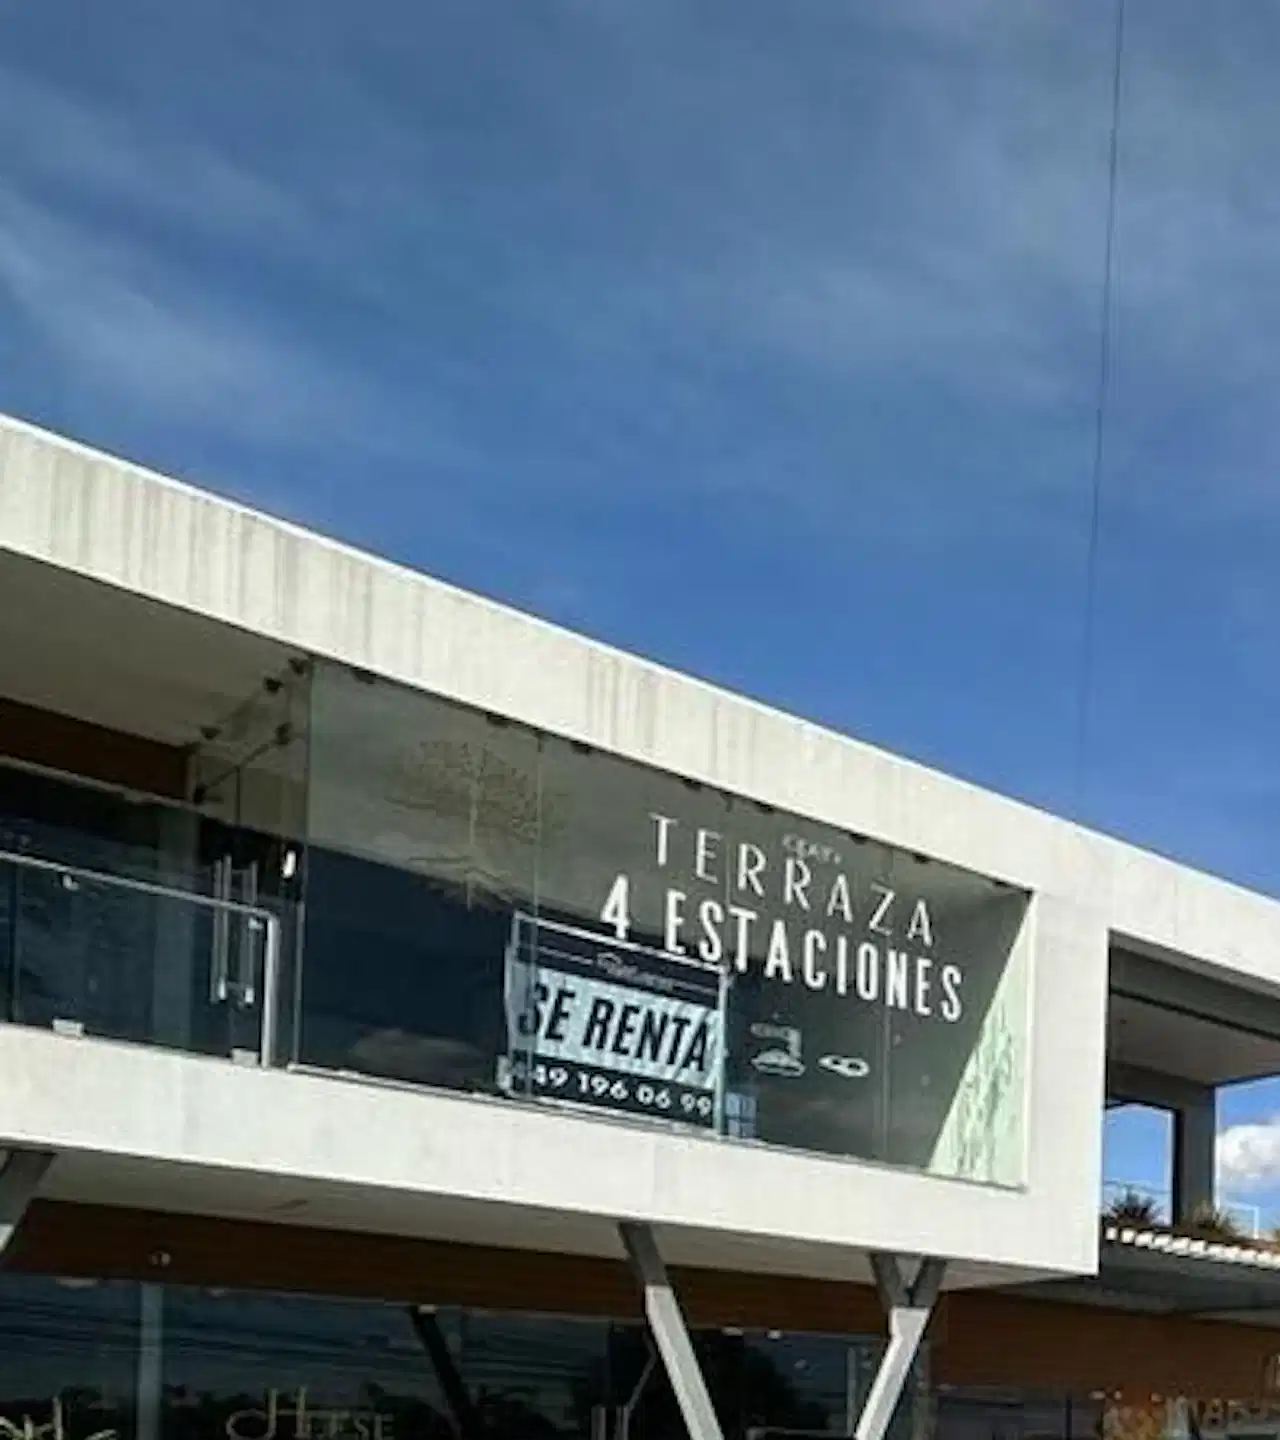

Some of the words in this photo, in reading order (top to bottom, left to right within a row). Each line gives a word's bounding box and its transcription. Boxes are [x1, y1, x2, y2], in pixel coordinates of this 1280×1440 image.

[650, 812, 933, 947] TERRAZA
[601, 875, 631, 940] 4
[663, 887, 962, 1022] ESTACIONES
[518, 983, 576, 1042] SE
[581, 997, 709, 1072] RENTA
